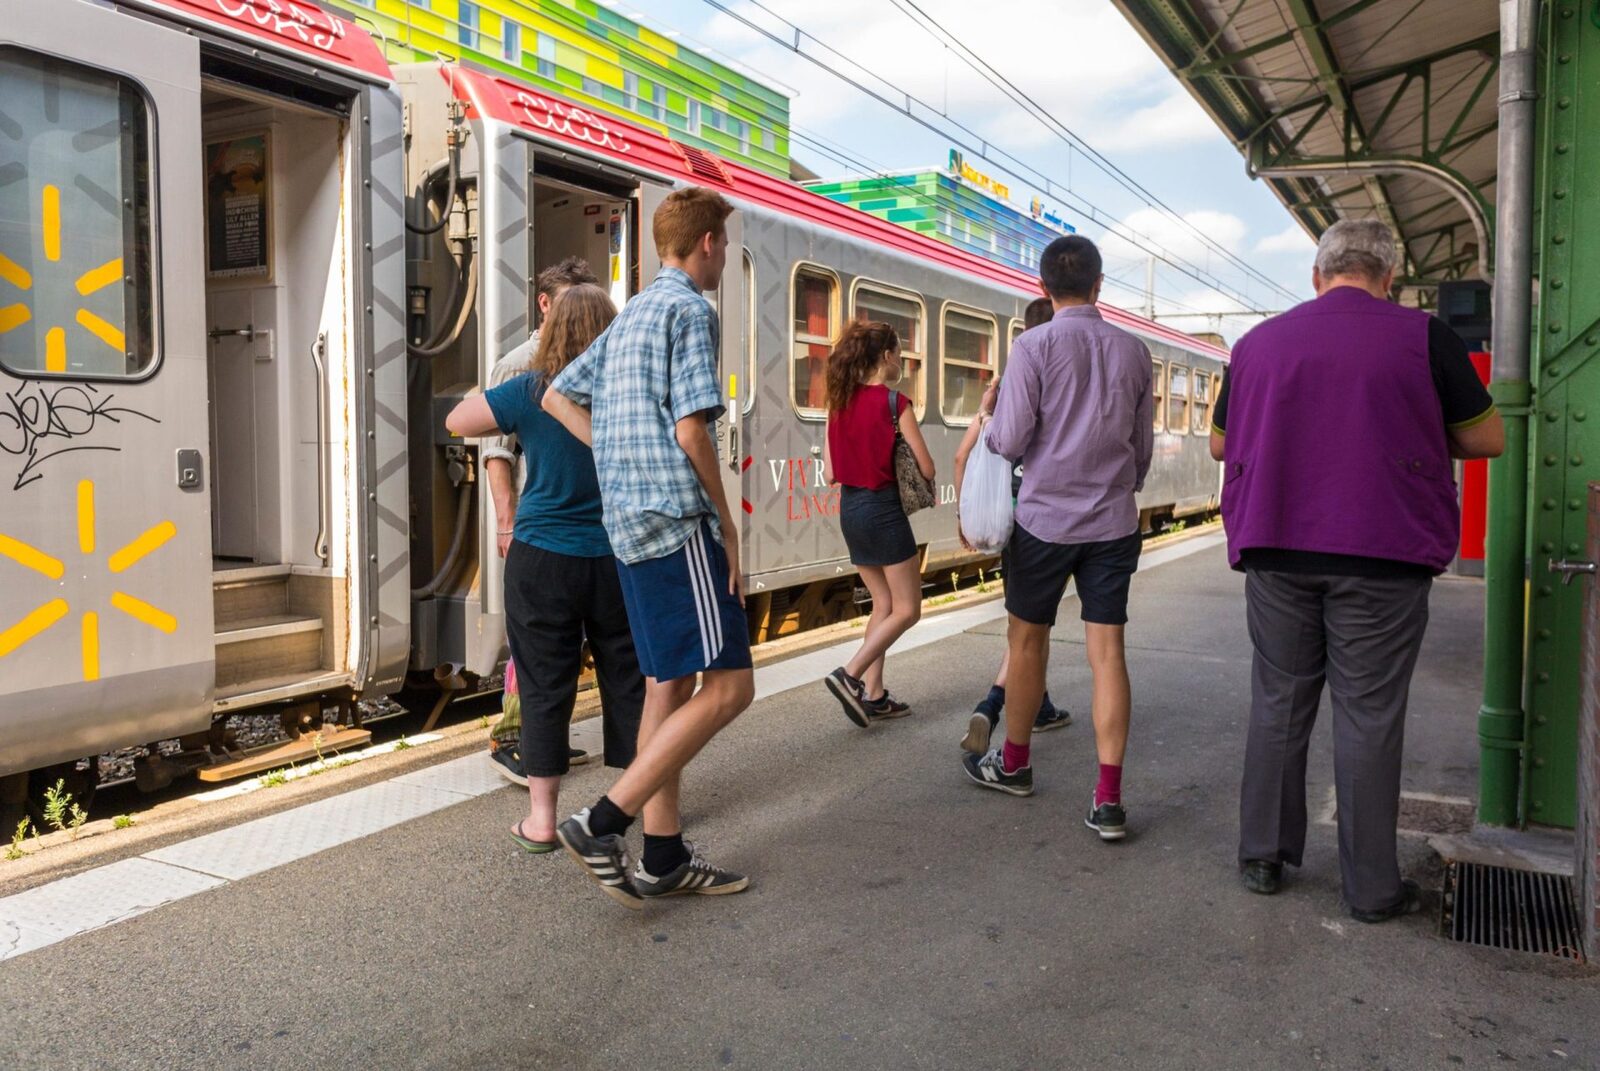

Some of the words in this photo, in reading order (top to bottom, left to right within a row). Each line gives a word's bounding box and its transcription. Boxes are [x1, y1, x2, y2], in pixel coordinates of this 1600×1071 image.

[769, 458, 842, 492] VIVR
[787, 493, 841, 520] LANG
[940, 484, 957, 504] LO
